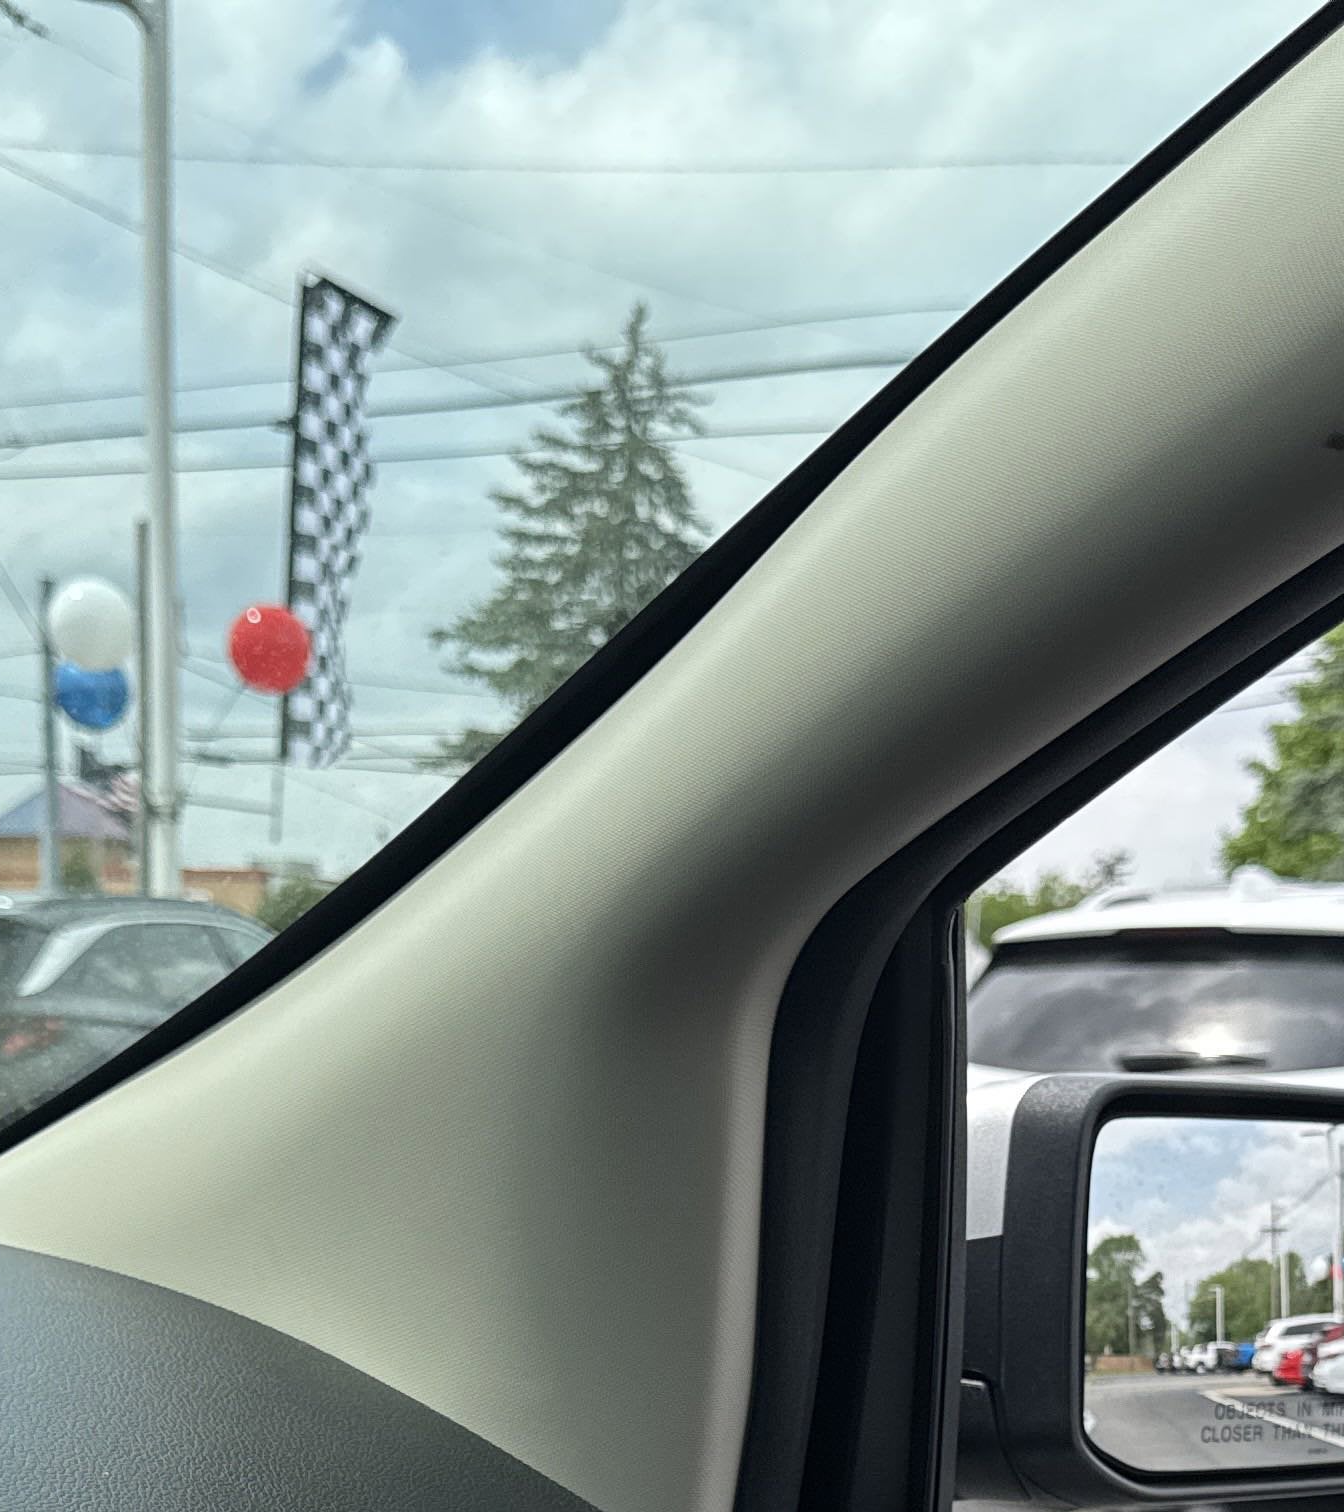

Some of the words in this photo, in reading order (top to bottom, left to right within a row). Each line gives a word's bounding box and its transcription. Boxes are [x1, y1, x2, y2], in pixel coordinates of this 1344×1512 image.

[1214, 1402, 1286, 1420] OBJECTS
[1297, 1401, 1312, 1417] IN
[1200, 1425, 1264, 1443] CLOSER
[1273, 1423, 1313, 1441] THAN
